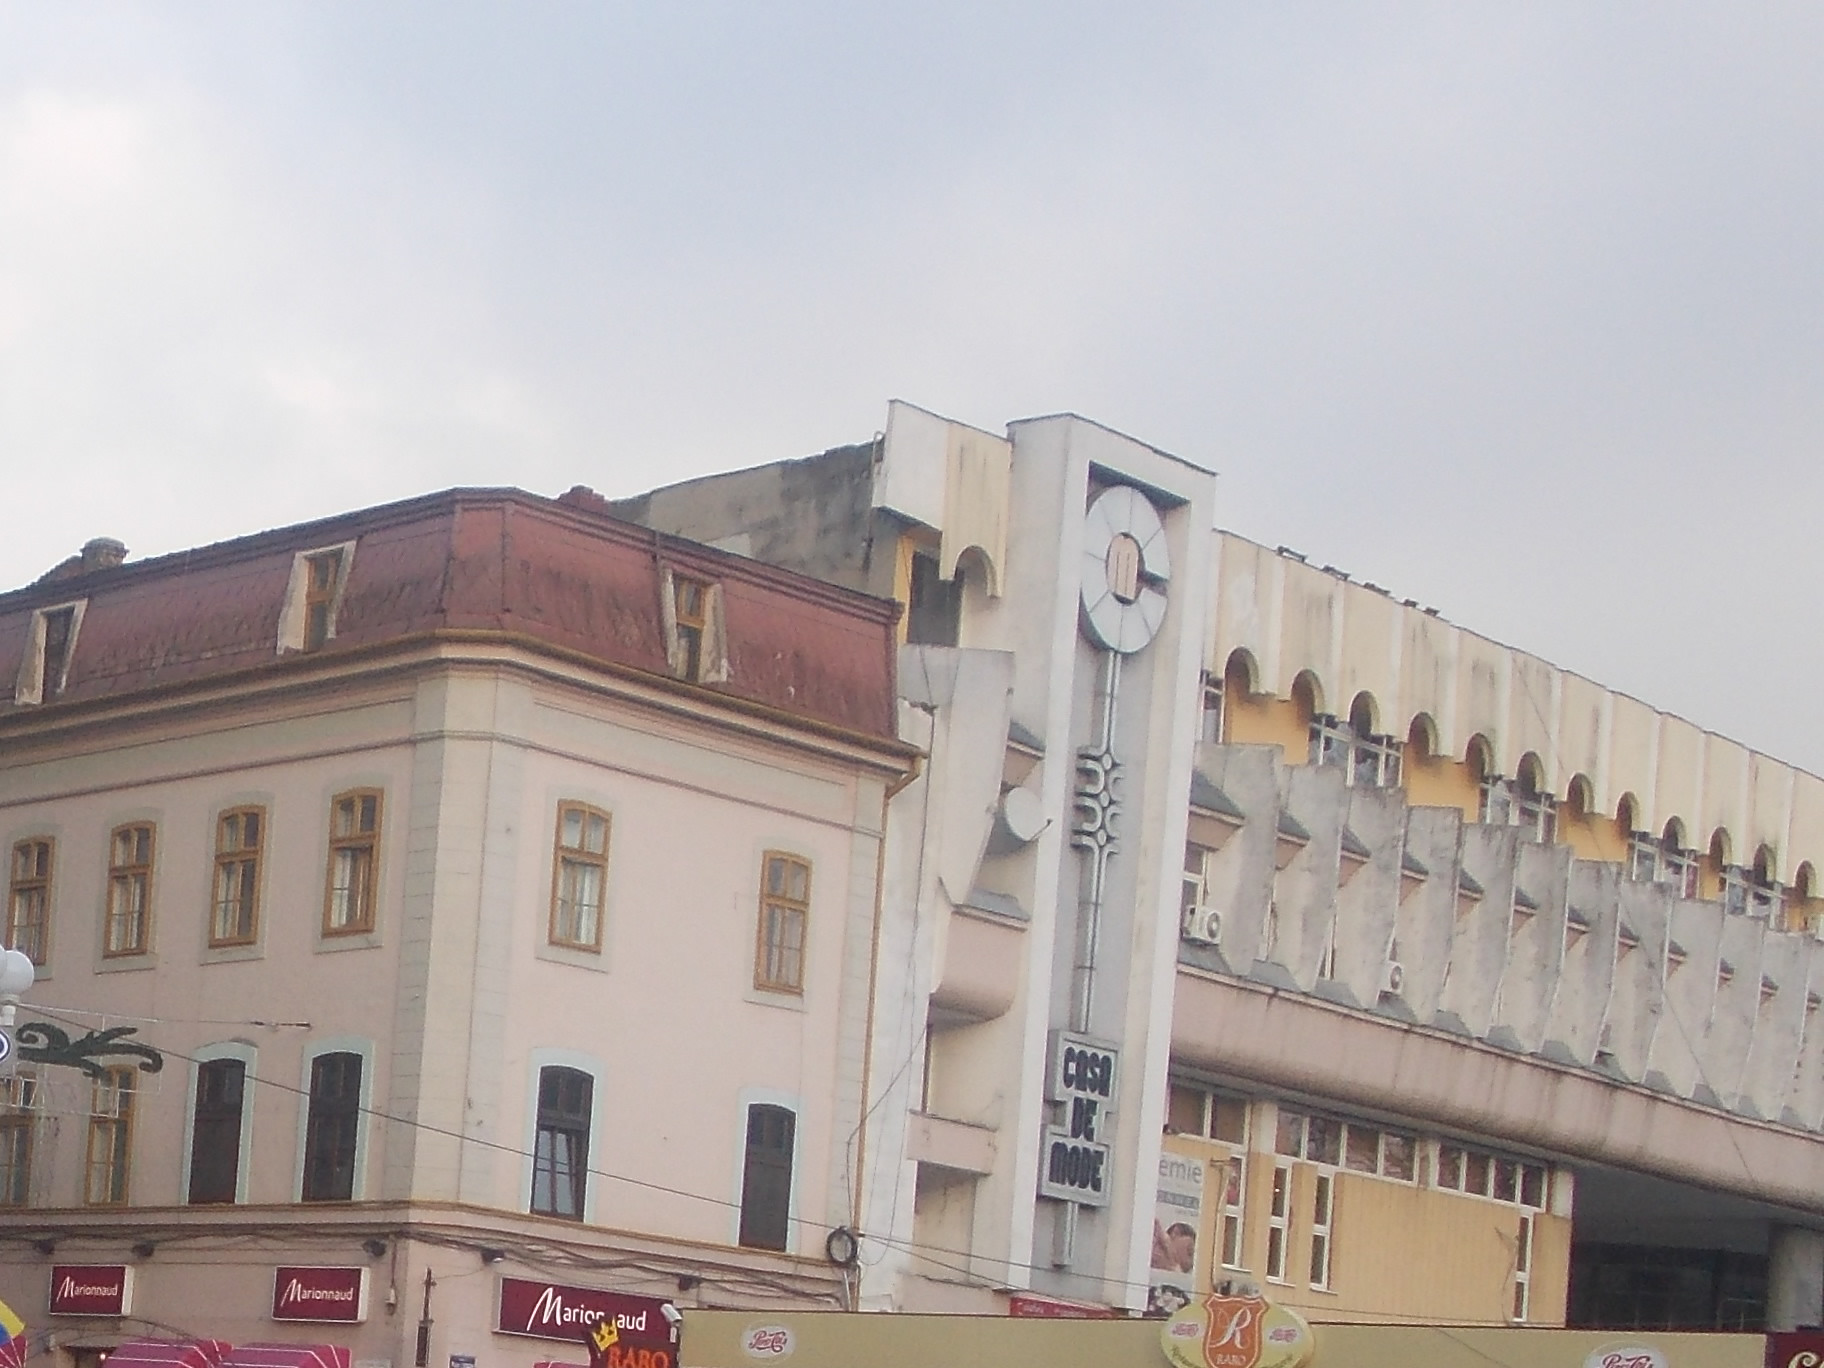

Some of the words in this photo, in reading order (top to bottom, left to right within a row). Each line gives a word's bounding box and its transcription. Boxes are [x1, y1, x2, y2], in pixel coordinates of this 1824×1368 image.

[1063, 1047, 1112, 1097] CASA
[1071, 1096, 1098, 1142] DE
[1048, 1142, 1105, 1192] MODE
[56, 1275, 118, 1302] Marionnaud
[280, 1279, 354, 1307] Marionnaud
[527, 1287, 647, 1332] Marionaud
